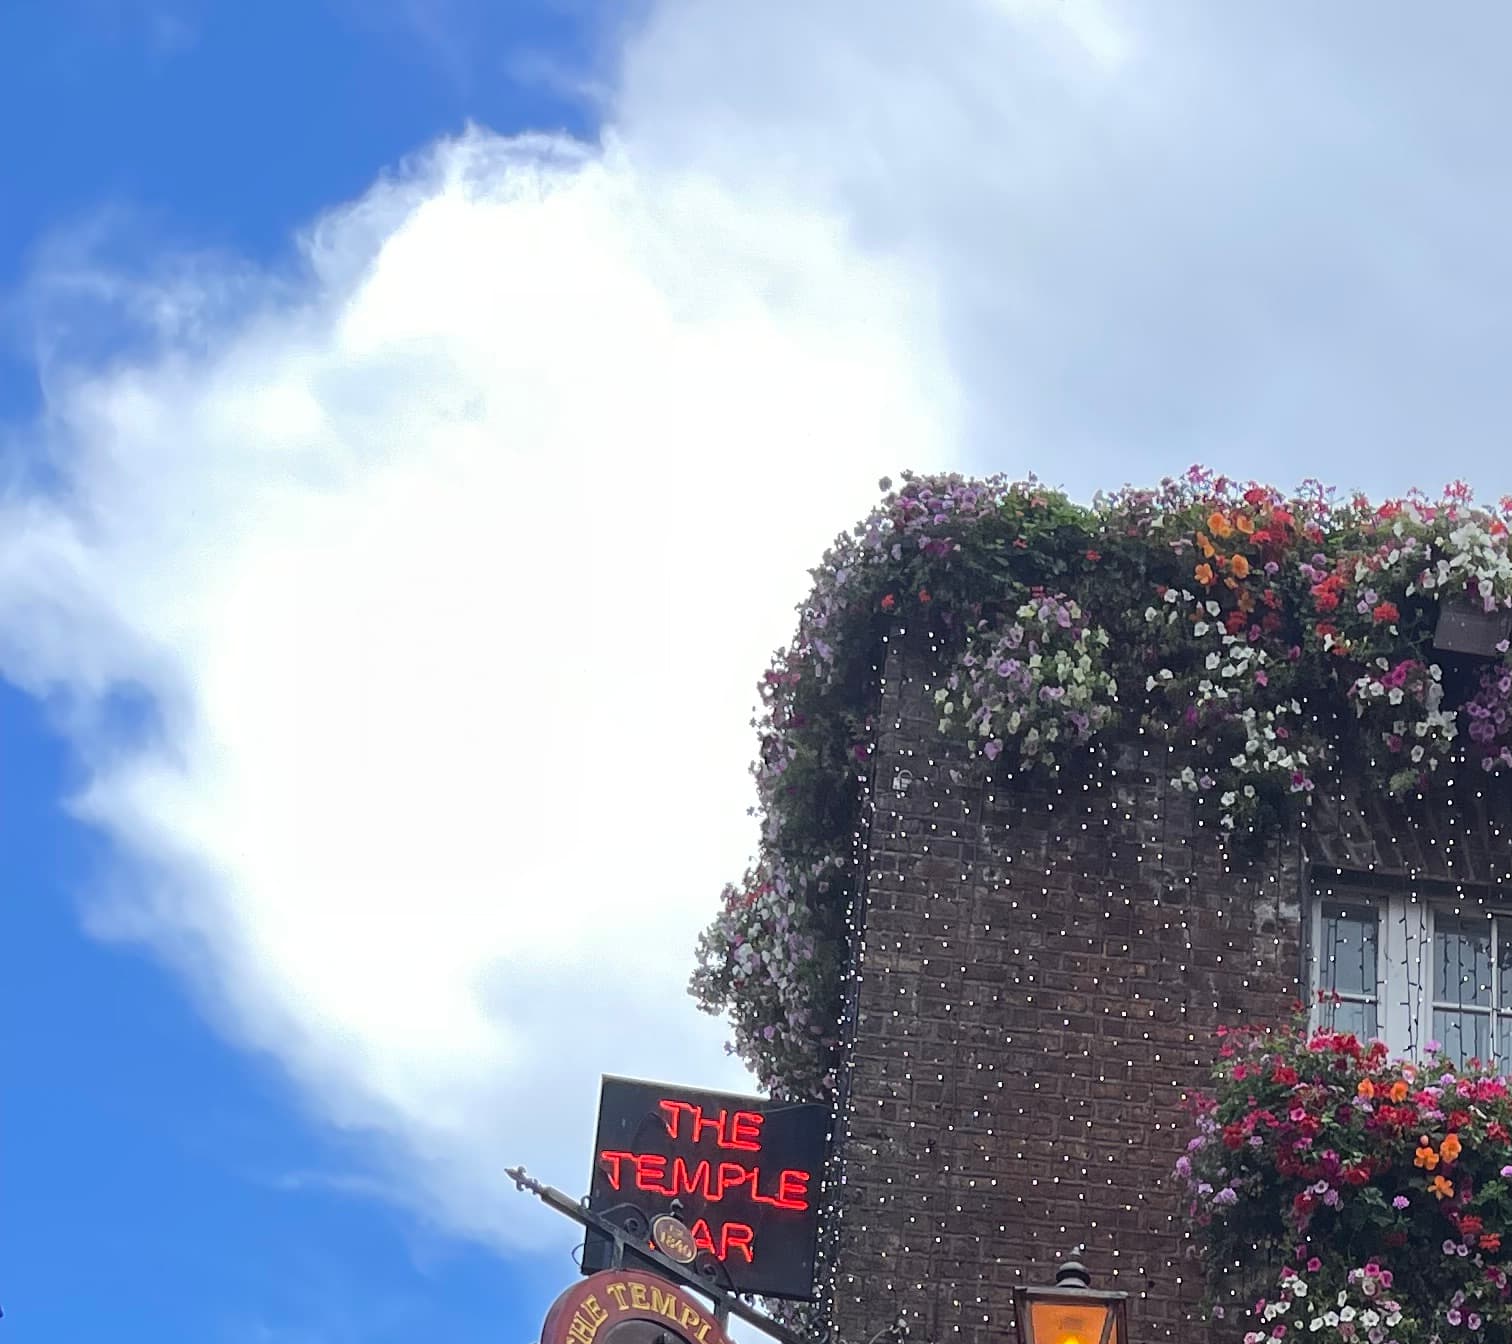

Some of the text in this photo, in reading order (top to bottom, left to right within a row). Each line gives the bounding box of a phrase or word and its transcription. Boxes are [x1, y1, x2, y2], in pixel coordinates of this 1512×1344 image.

[660, 1099, 764, 1151] THE
[601, 1150, 810, 1211] TEMPLE
[690, 1218, 754, 1263] AR
